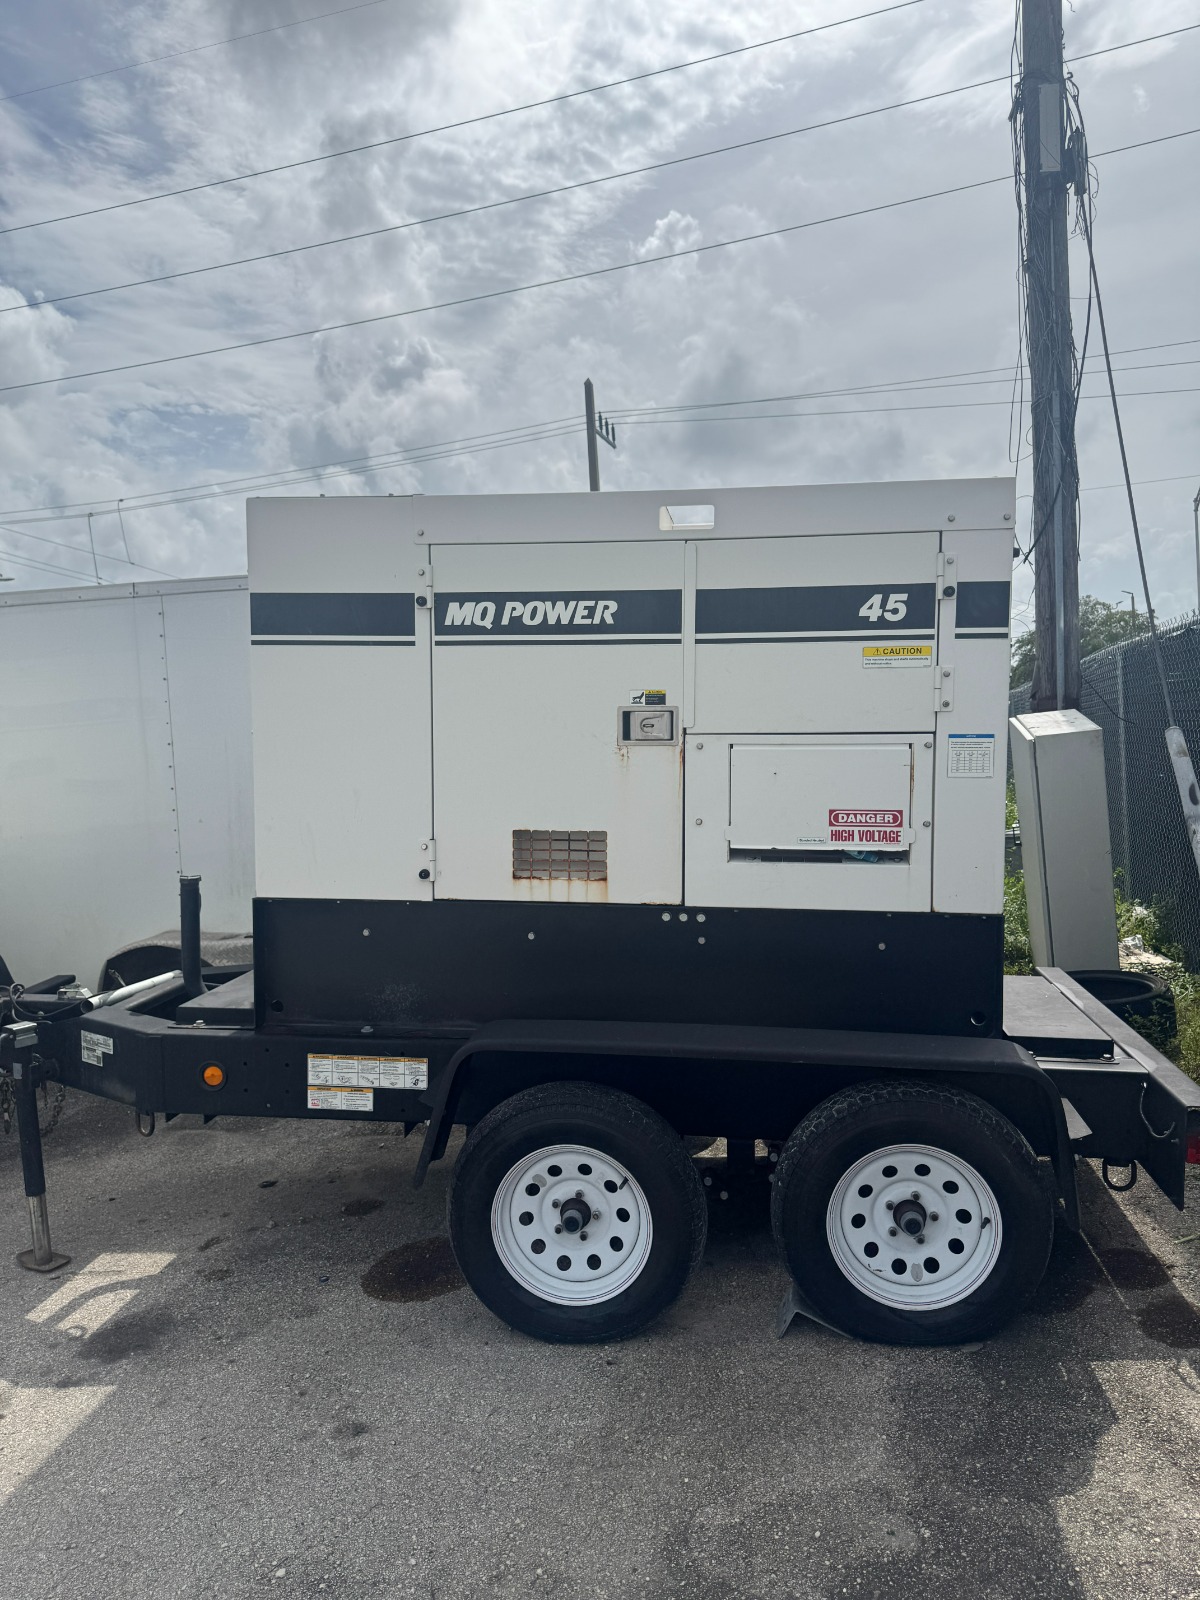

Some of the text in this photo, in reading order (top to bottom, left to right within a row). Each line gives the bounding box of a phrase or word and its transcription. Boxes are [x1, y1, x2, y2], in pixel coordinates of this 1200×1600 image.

[858, 593, 909, 622] 45
[444, 600, 618, 630] MQ POWER
[882, 647, 922, 655] CAUTION
[838, 813, 894, 823] DANGER
[830, 829, 902, 843] HIGH VOLTAGE
